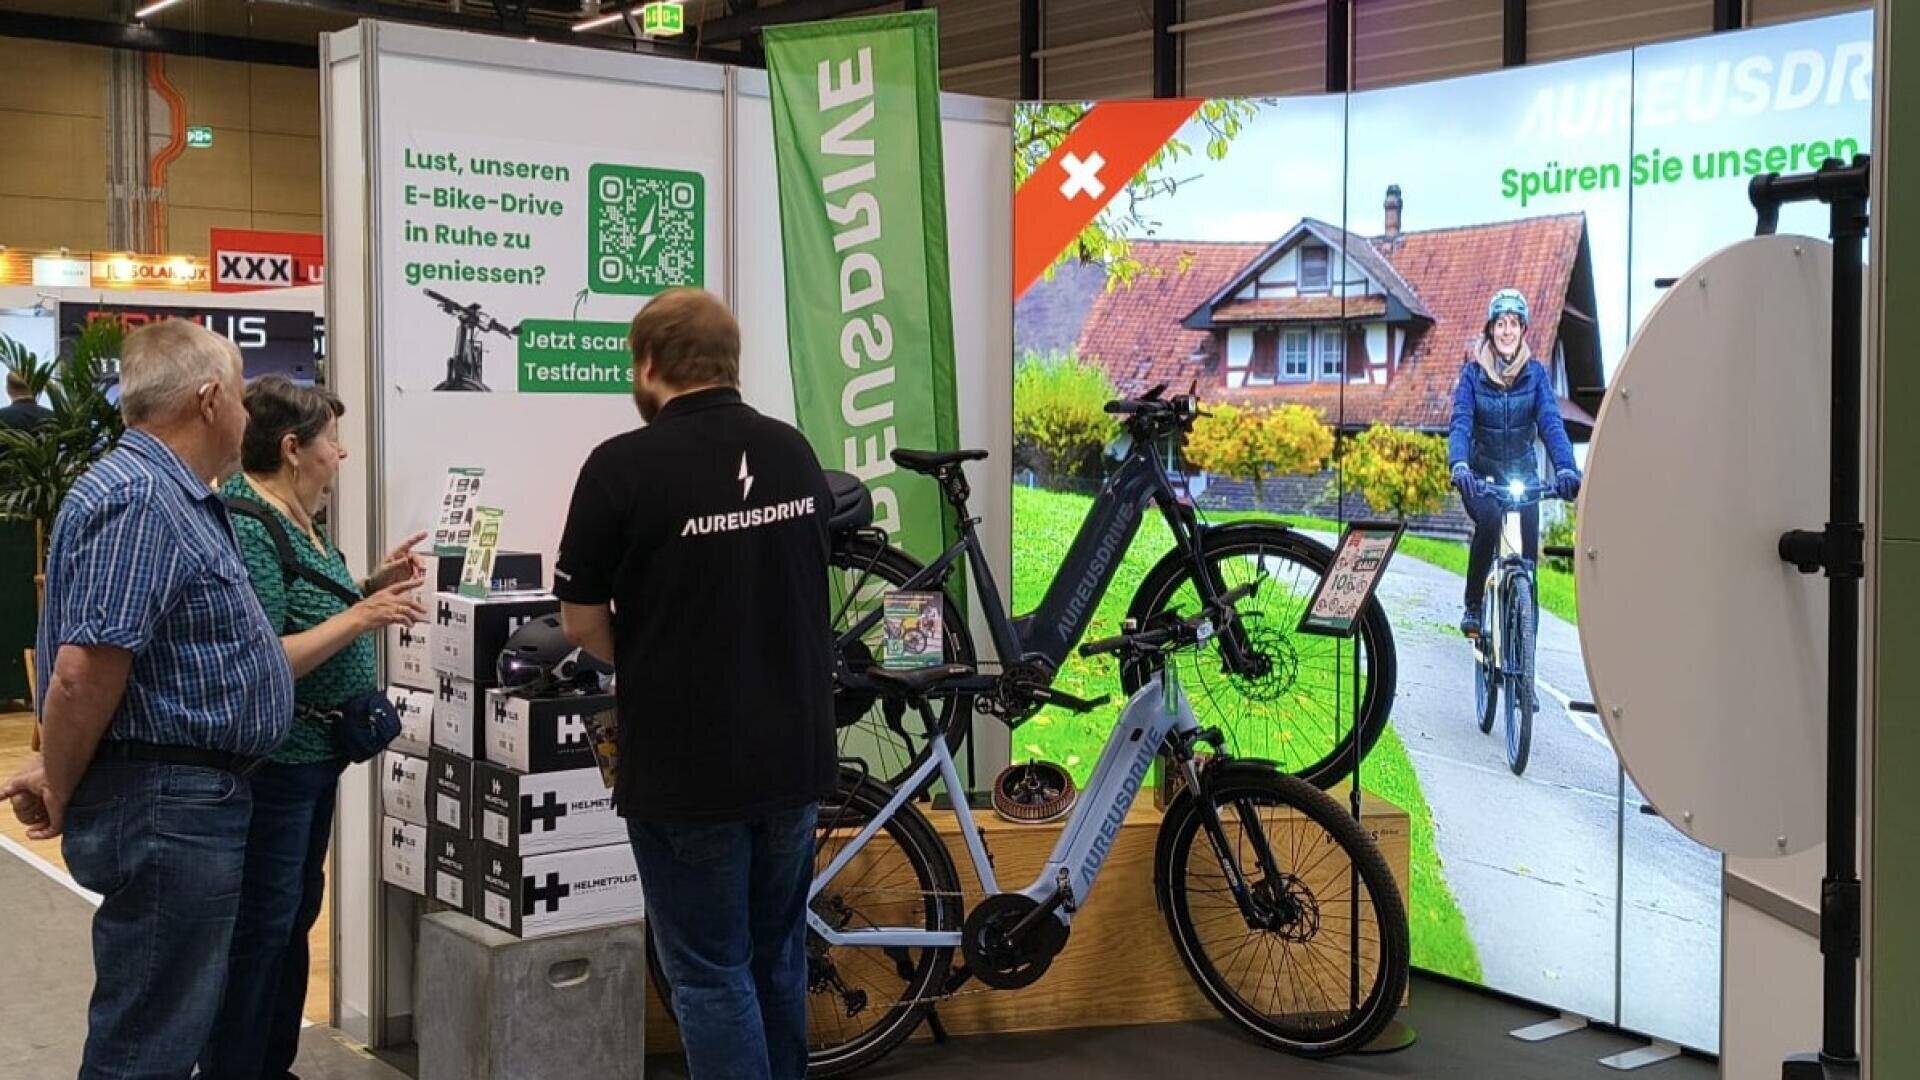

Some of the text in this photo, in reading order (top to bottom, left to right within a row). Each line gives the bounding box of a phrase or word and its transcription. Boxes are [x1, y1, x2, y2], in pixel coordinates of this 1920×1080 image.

[404, 148, 570, 182] Lust, unseren
[1502, 136, 1859, 208] Spüren Sie unseren
[404, 185, 564, 216] E-Bike-Drive
[404, 219, 532, 249] in Ruhe zu
[404, 259, 546, 285] geniessen?
[524, 331, 576, 351] Jetzt
[524, 361, 621, 383] Testfahrt
[681, 497, 816, 537] AUREUSDRIVE
[1058, 501, 1135, 642] AUREUSDRIVE
[1081, 727, 1163, 888] AUREUSDRIVE
